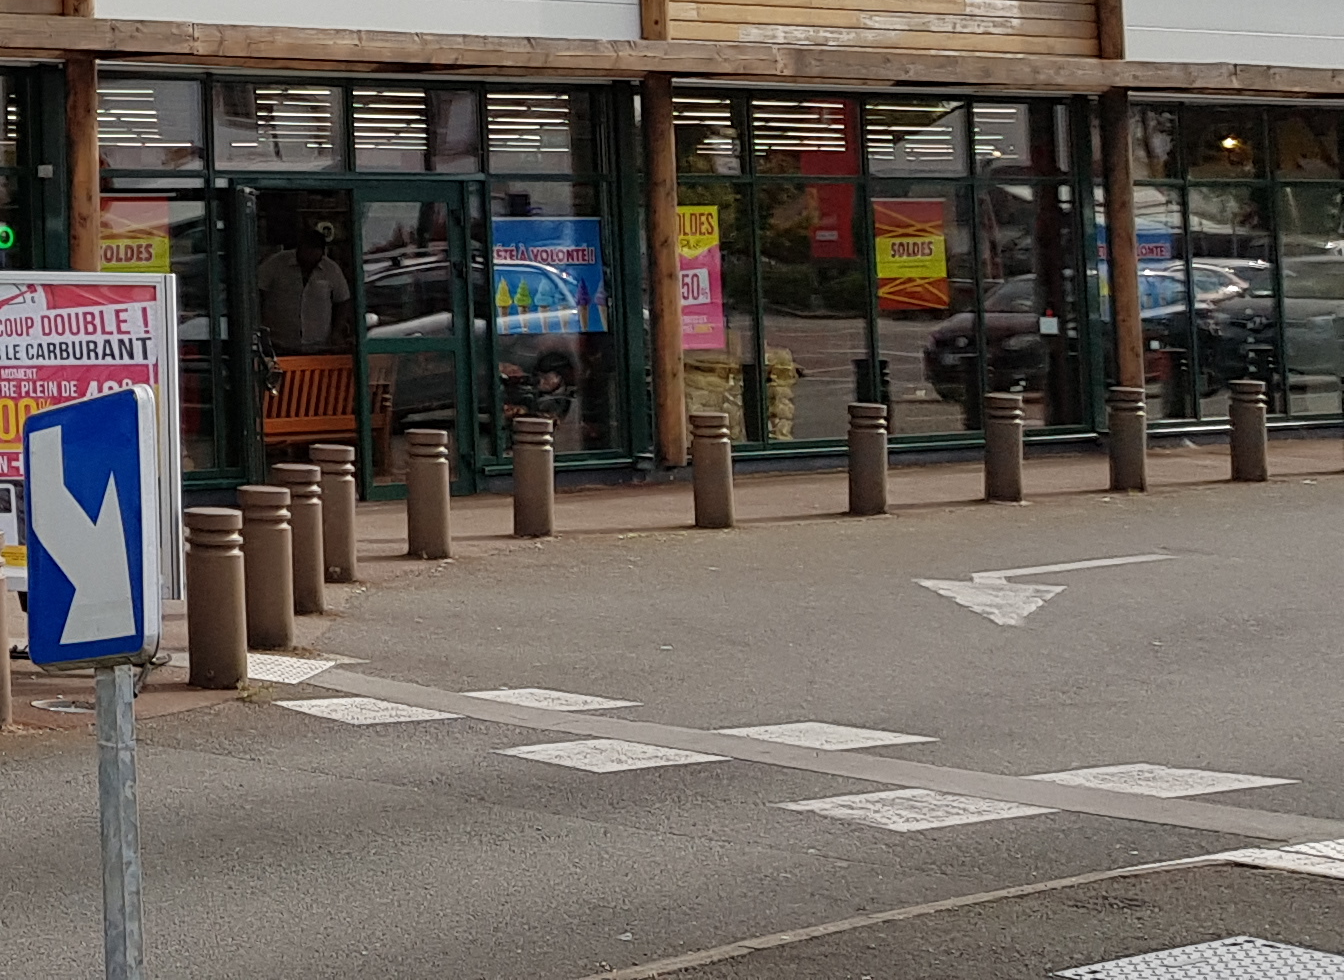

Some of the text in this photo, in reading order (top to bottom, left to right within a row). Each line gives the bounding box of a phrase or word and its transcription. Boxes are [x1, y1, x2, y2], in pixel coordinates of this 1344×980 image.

[100, 243, 153, 263] OLDES
[890, 241, 934, 259] SOLDES
[41, 308, 131, 336] DOUBLE
[6, 344, 21, 360] LE
[26, 337, 152, 361] CARBURANT
[1, 368, 38, 379] MOMENT
[21, 380, 58, 397] PLEIN
[62, 381, 78, 397] DE
